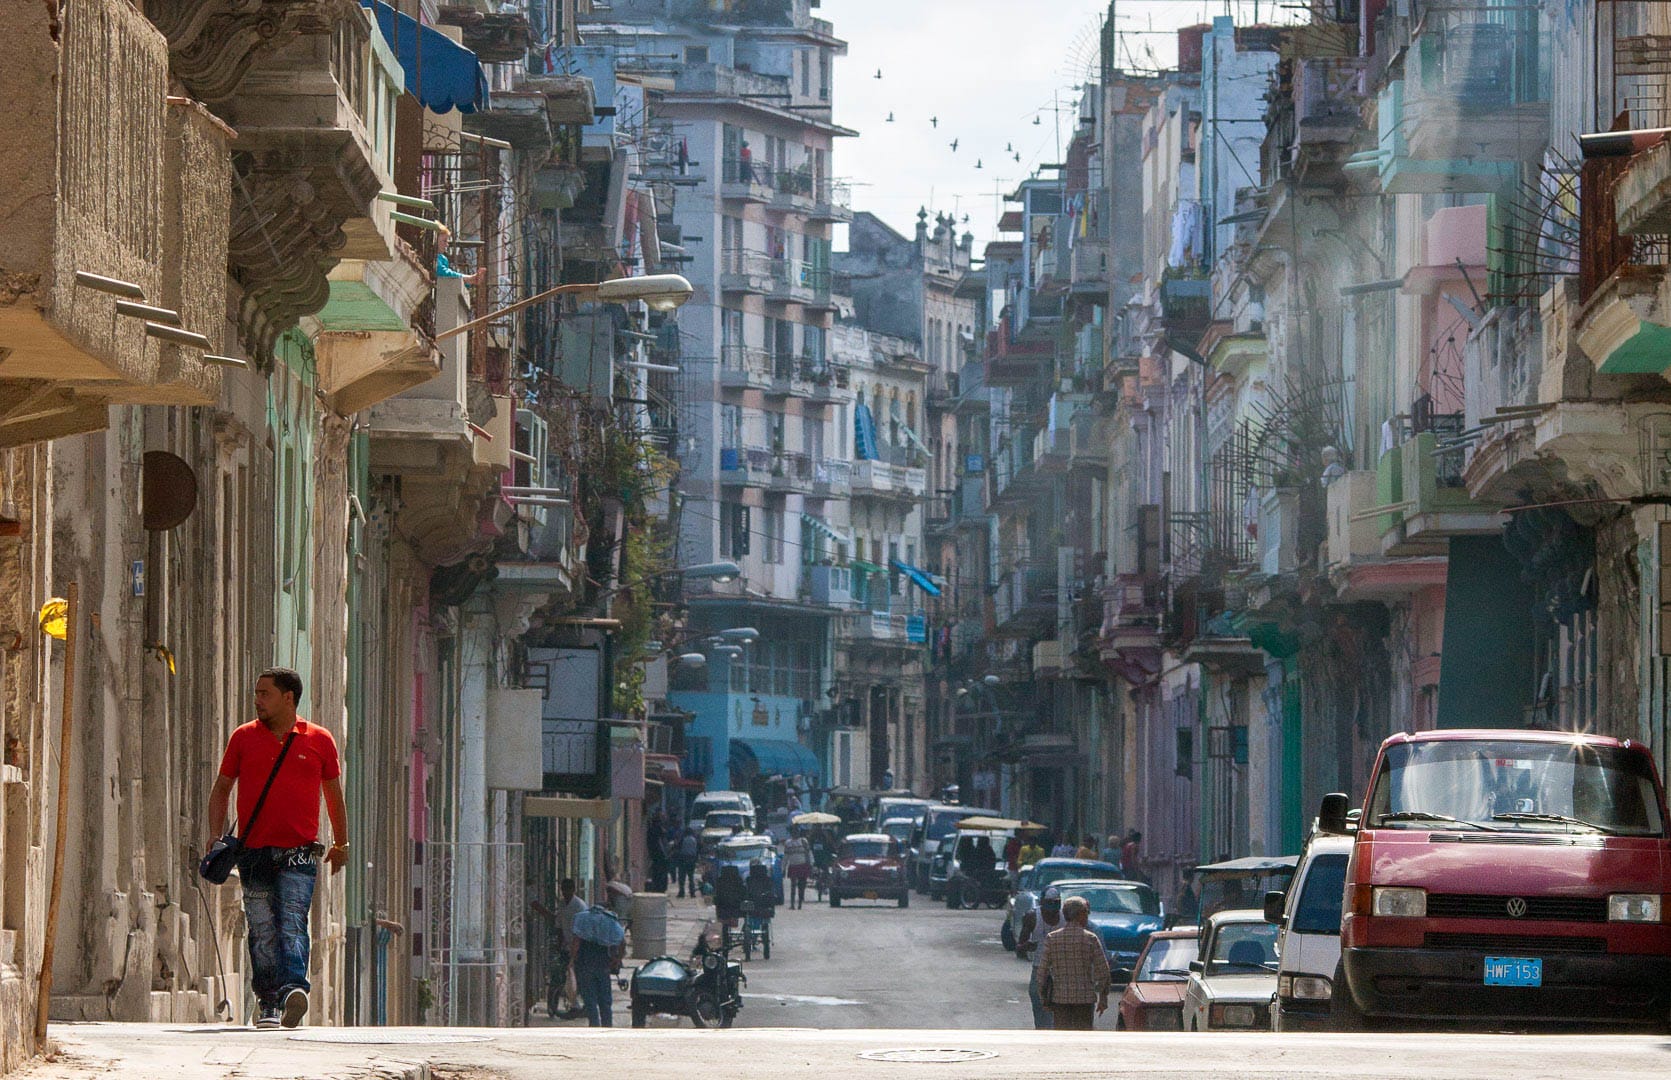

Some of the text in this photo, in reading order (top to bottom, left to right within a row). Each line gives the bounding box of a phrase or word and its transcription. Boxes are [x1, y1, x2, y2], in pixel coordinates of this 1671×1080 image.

[1507, 897, 1526, 917] VW
[1485, 964, 1540, 980] HWF 153
